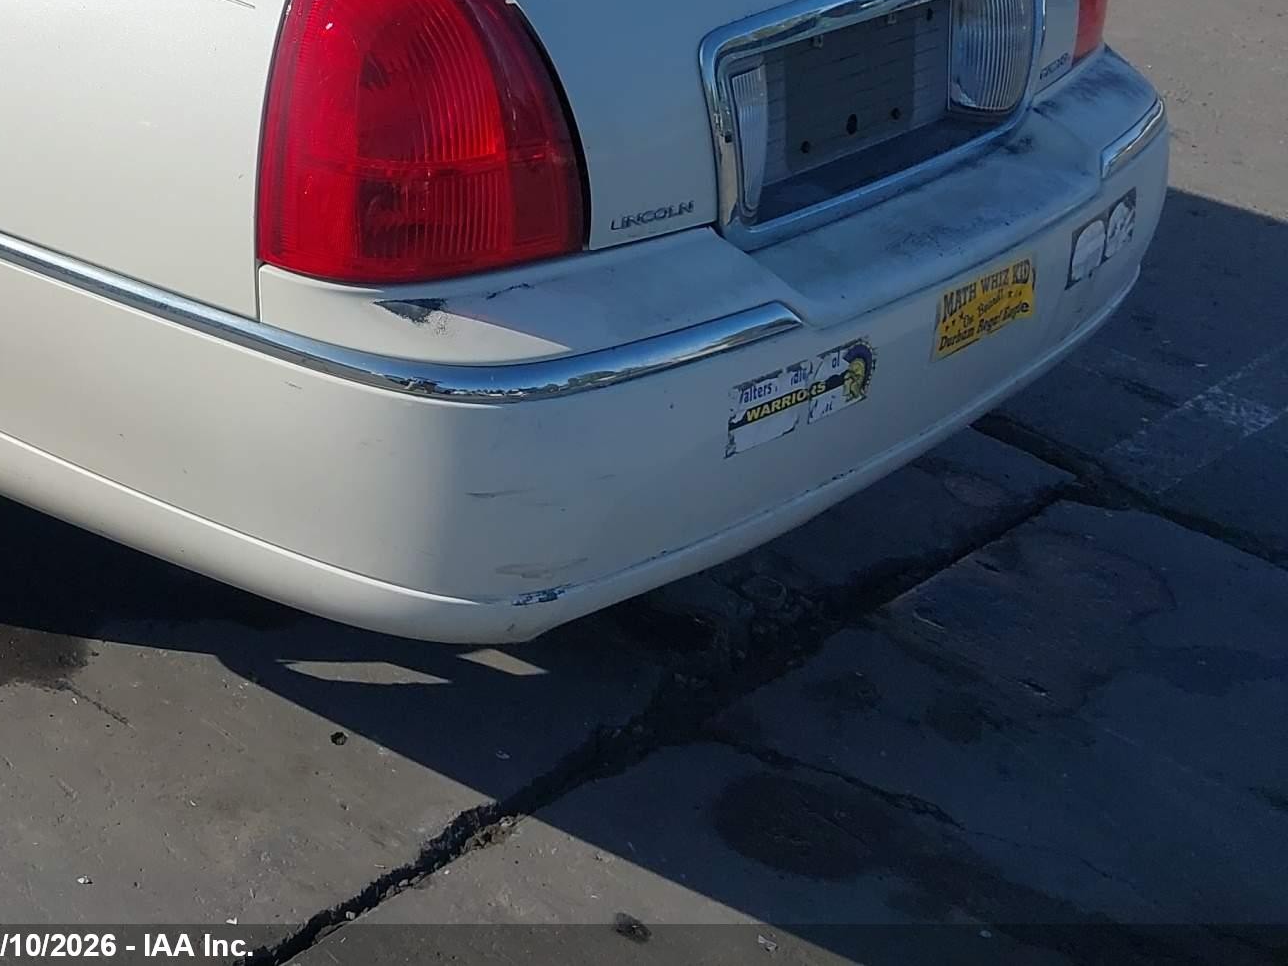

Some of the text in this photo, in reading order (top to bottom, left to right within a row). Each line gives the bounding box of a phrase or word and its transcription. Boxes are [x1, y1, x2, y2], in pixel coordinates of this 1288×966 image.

[610, 201, 695, 231] LINCOLN
[942, 259, 1031, 322] MATH WHIZ KID
